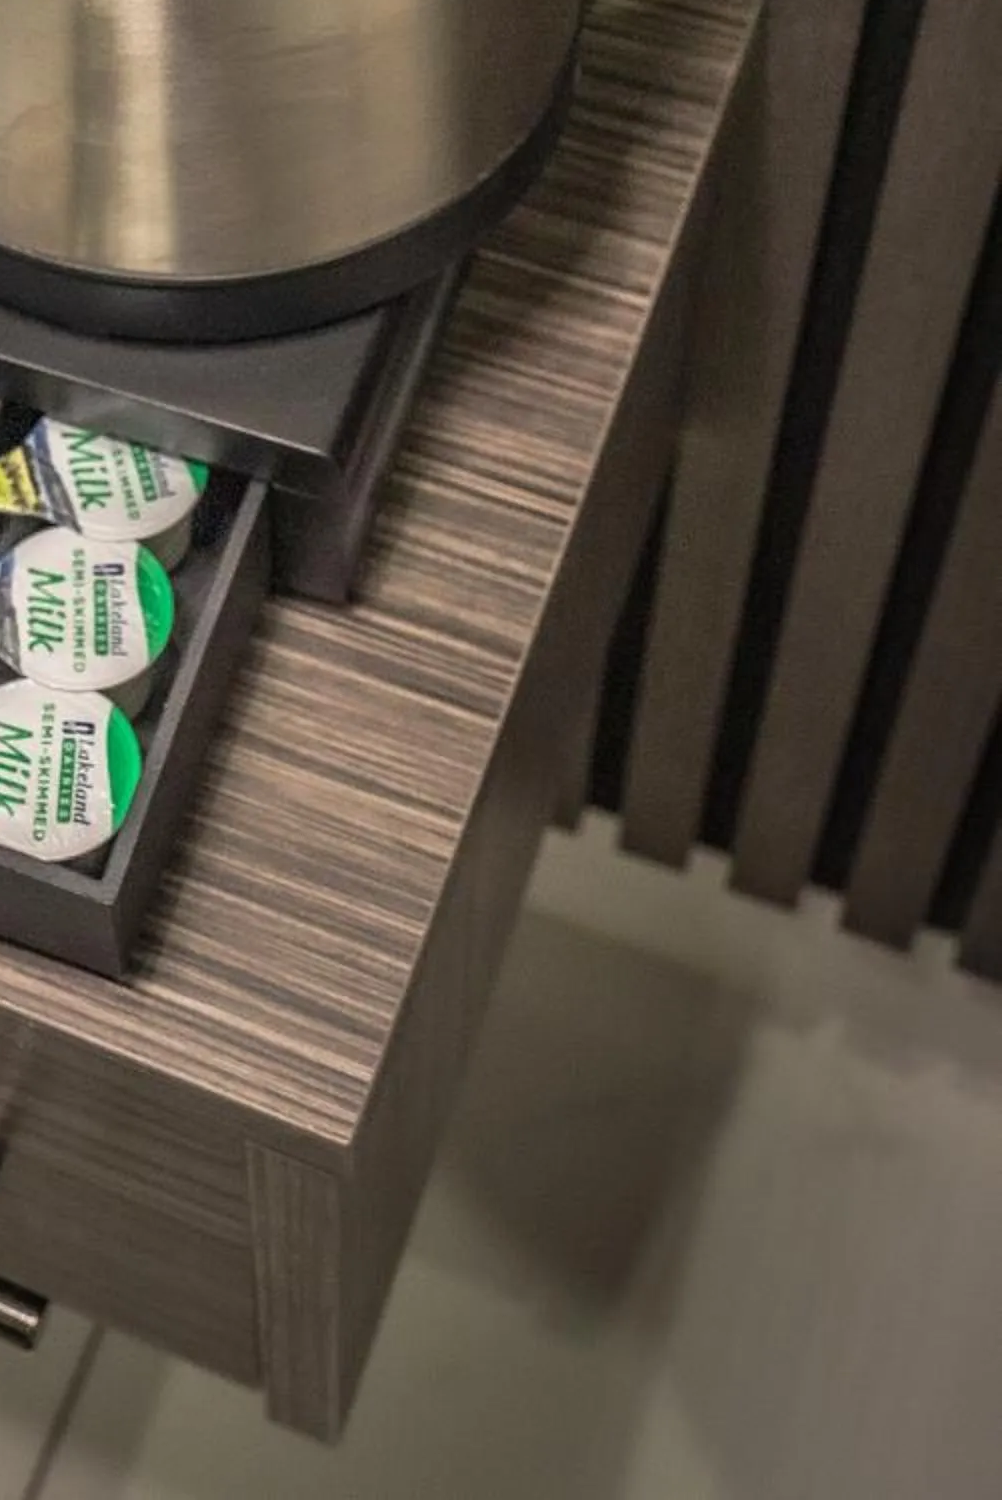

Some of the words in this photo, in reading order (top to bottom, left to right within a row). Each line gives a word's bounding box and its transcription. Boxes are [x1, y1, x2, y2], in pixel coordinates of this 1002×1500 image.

[62, 429, 113, 511] Milk
[112, 448, 141, 522] SKIMMED
[27, 567, 66, 653] Milk
[72, 549, 86, 673] SEMI-SKIMMED
[109, 578, 129, 657] Lakeland
[33, 703, 56, 842] SEMI-SKIMMED
[74, 738, 95, 826] Lakeland
